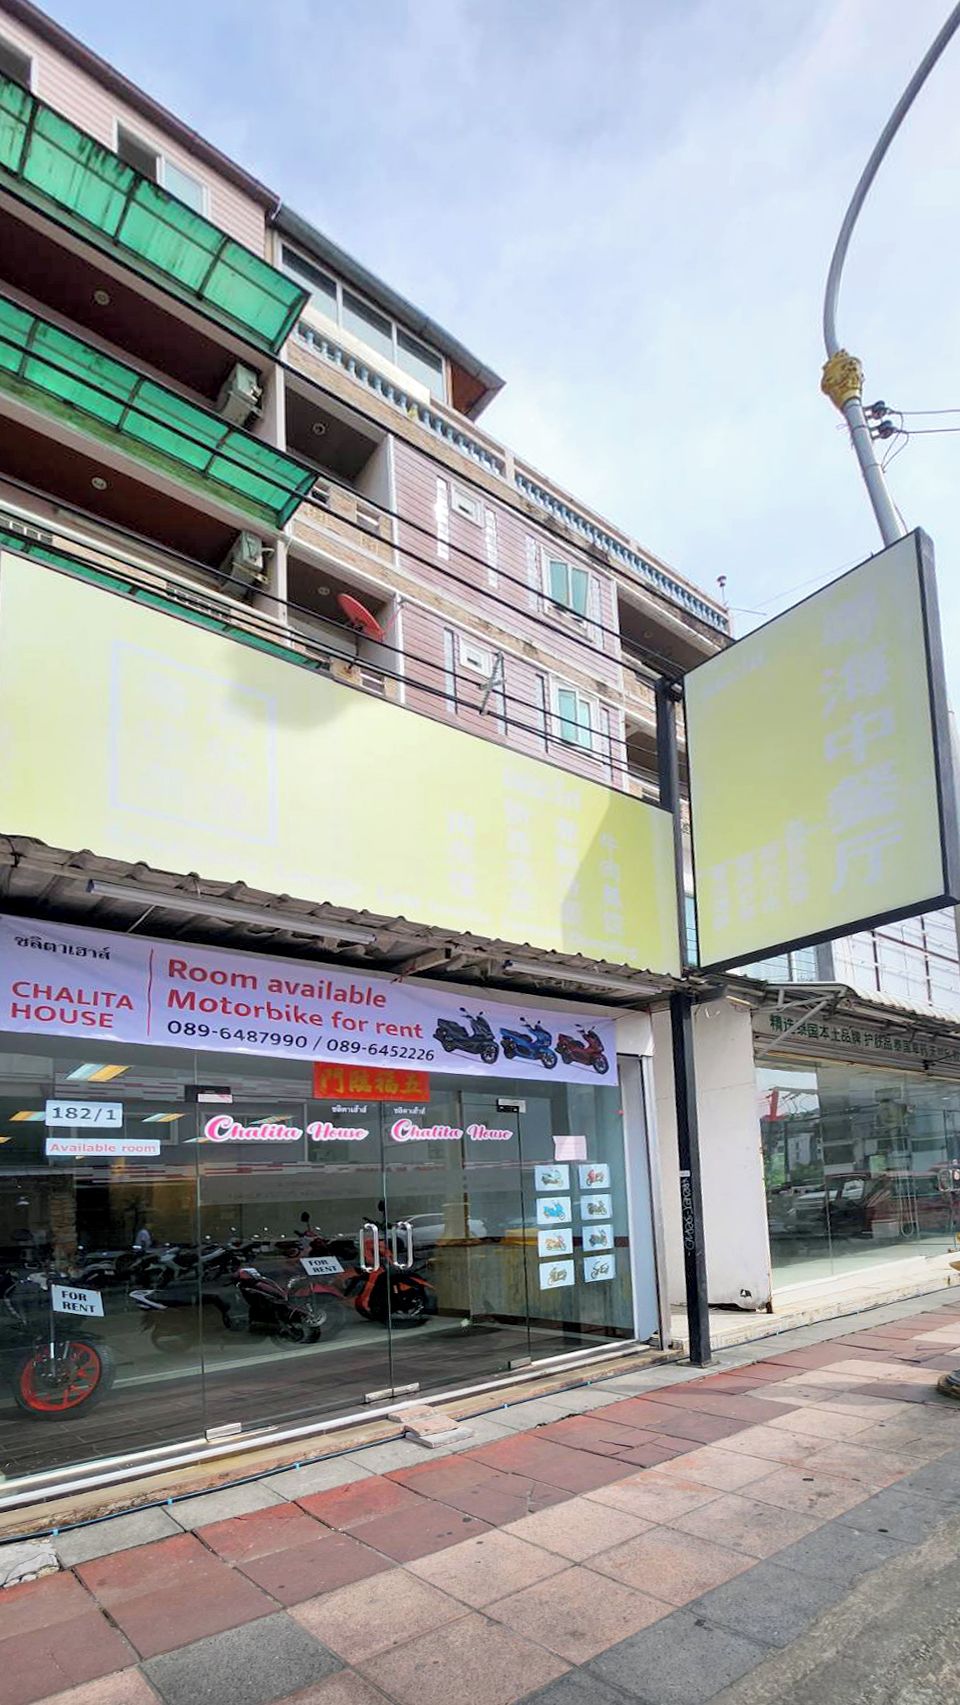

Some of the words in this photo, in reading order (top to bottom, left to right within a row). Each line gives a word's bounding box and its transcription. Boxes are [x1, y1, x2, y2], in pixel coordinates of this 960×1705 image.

[168, 958, 257, 989] Room
[268, 978, 387, 1008] available
[12, 981, 134, 1010] CHALITA
[11, 1002, 114, 1028] HOUSE
[167, 989, 323, 1026] Motorbike
[331, 1011, 368, 1031] for
[376, 1022, 424, 1039] rent
[167, 1020, 307, 1048] 089-6487990
[327, 1038, 435, 1061] 089-6452226
[52, 1107, 117, 1122] 182/1
[205, 1115, 303, 1142] Chalita
[306, 1120, 369, 1141] House
[391, 1118, 464, 1142] Chalita
[467, 1124, 513, 1141] House
[50, 1142, 116, 1153] Available
[122, 1145, 157, 1153] room
[309, 1258, 329, 1266] FOR
[312, 1264, 338, 1273] RENT
[61, 1290, 88, 1301] FOR
[62, 1301, 97, 1313] RENT
